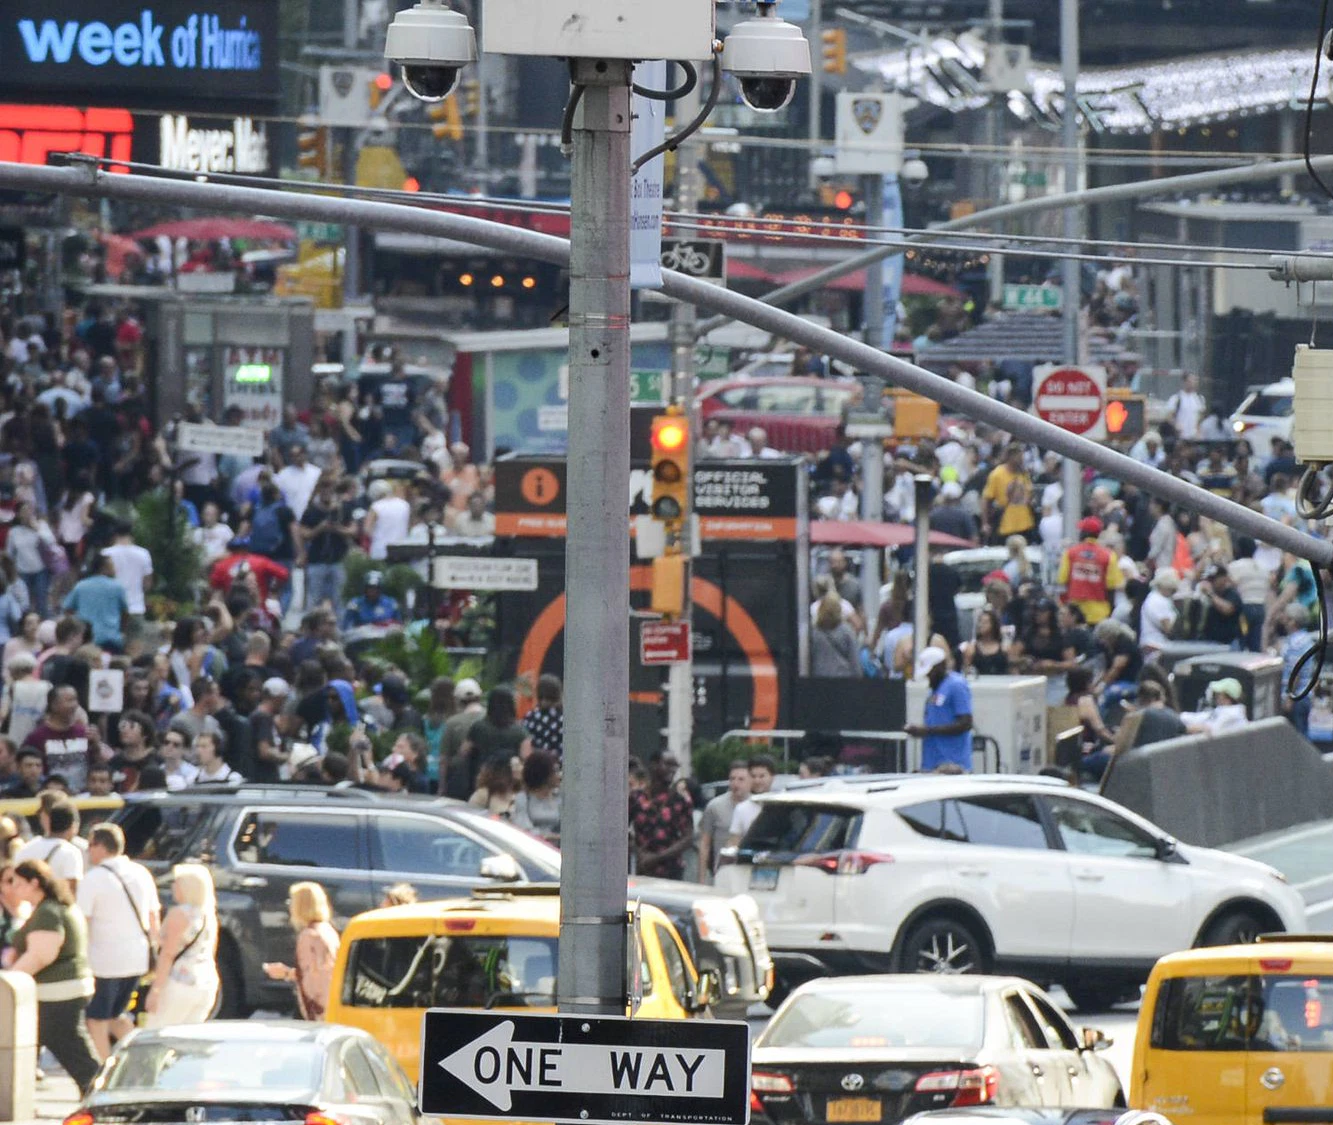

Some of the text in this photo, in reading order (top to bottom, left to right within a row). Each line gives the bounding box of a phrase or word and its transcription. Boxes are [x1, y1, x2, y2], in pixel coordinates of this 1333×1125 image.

[18, 9, 165, 67] week
[171, 13, 200, 68] of
[1046, 380, 1091, 393] DO NOT
[1048, 412, 1089, 424] ENTER
[694, 470, 768, 484] OFFICIAL
[694, 484, 760, 495] VISITOR
[694, 496, 770, 509] SERVICES
[473, 1045, 706, 1092] ONE WAY
[659, 1113, 733, 1122] TRANSPORTATION
